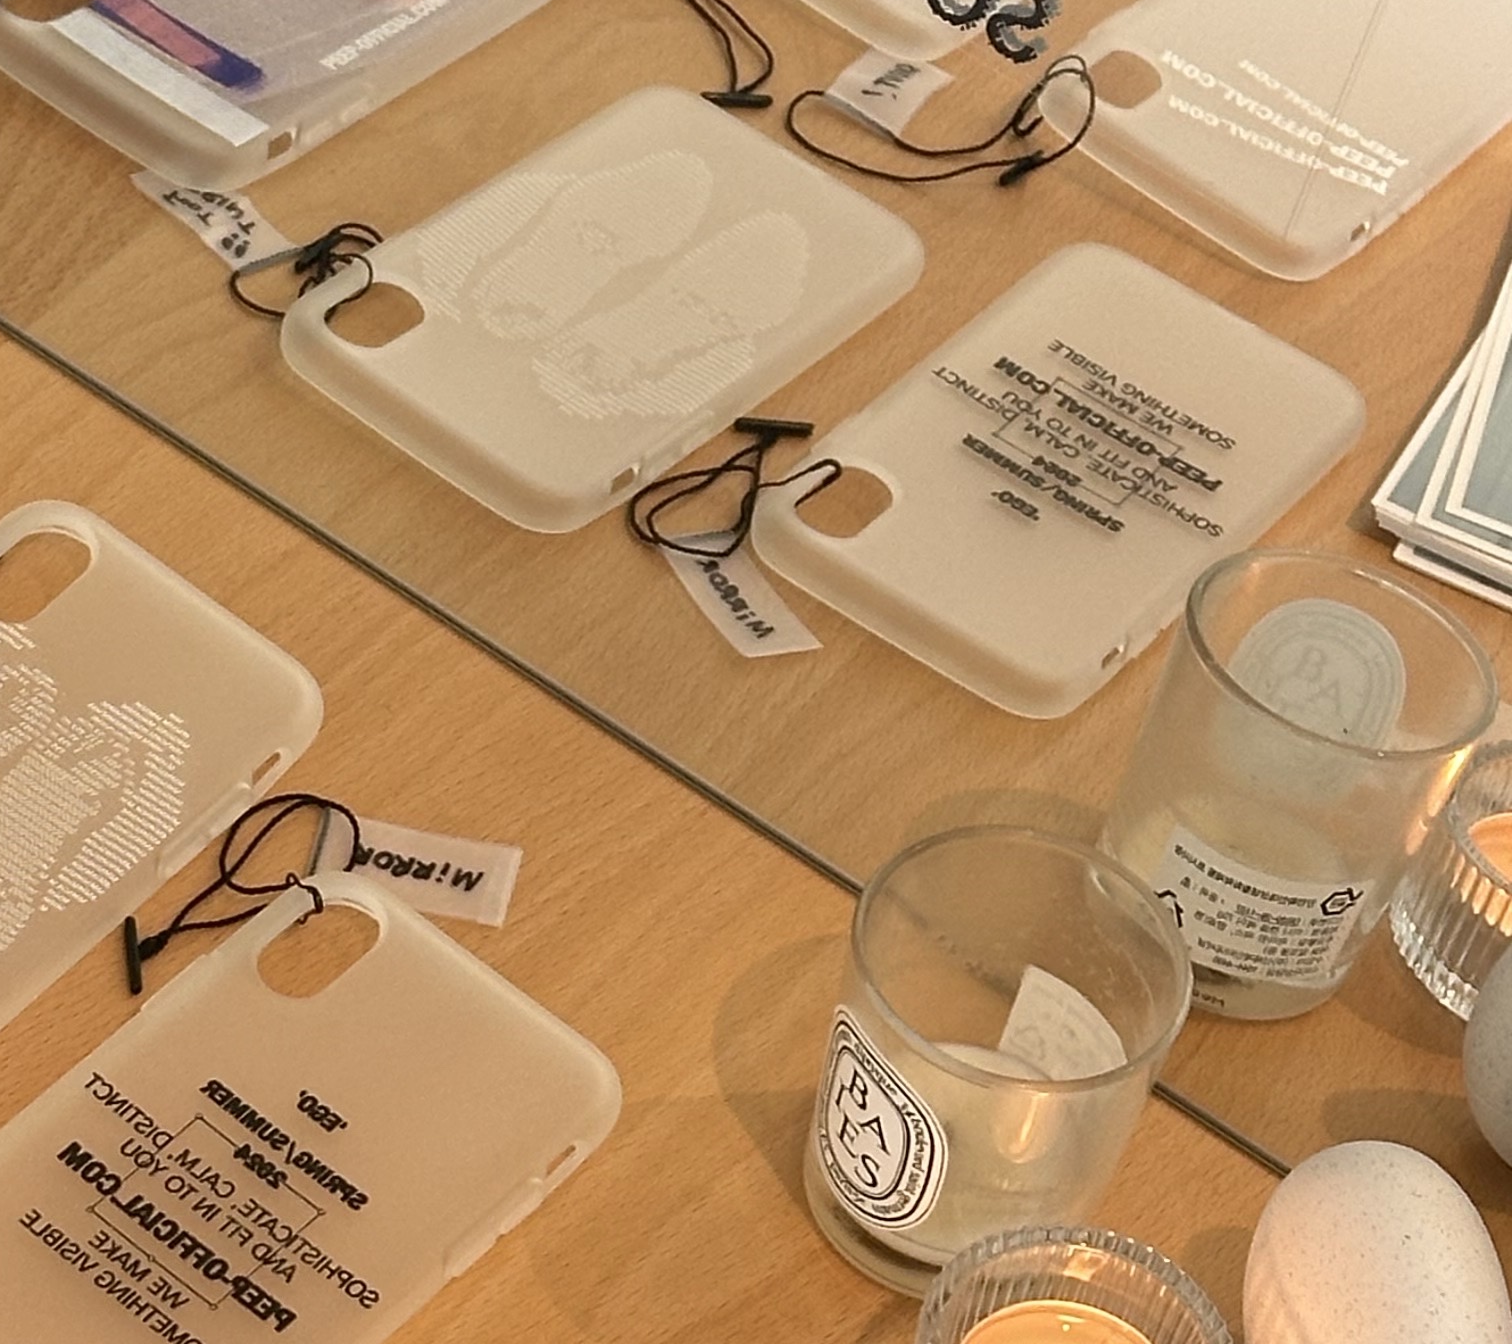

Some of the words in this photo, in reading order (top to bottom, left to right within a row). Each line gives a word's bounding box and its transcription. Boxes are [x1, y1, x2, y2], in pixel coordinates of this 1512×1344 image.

[1047, 339, 1118, 387] VISIBLE
[931, 365, 1022, 423] DISTINCT
[1001, 390, 1044, 422] YOU
[1082, 380, 1140, 416] MAKE
[1046, 417, 1076, 439] TO
[1120, 382, 1237, 451] SOMETHING
[1141, 413, 1175, 437] WE
[1073, 435, 1100, 452] IN
[1098, 448, 1134, 471] FIT
[1032, 455, 1083, 488] 2024
[1131, 467, 1179, 494] AND
